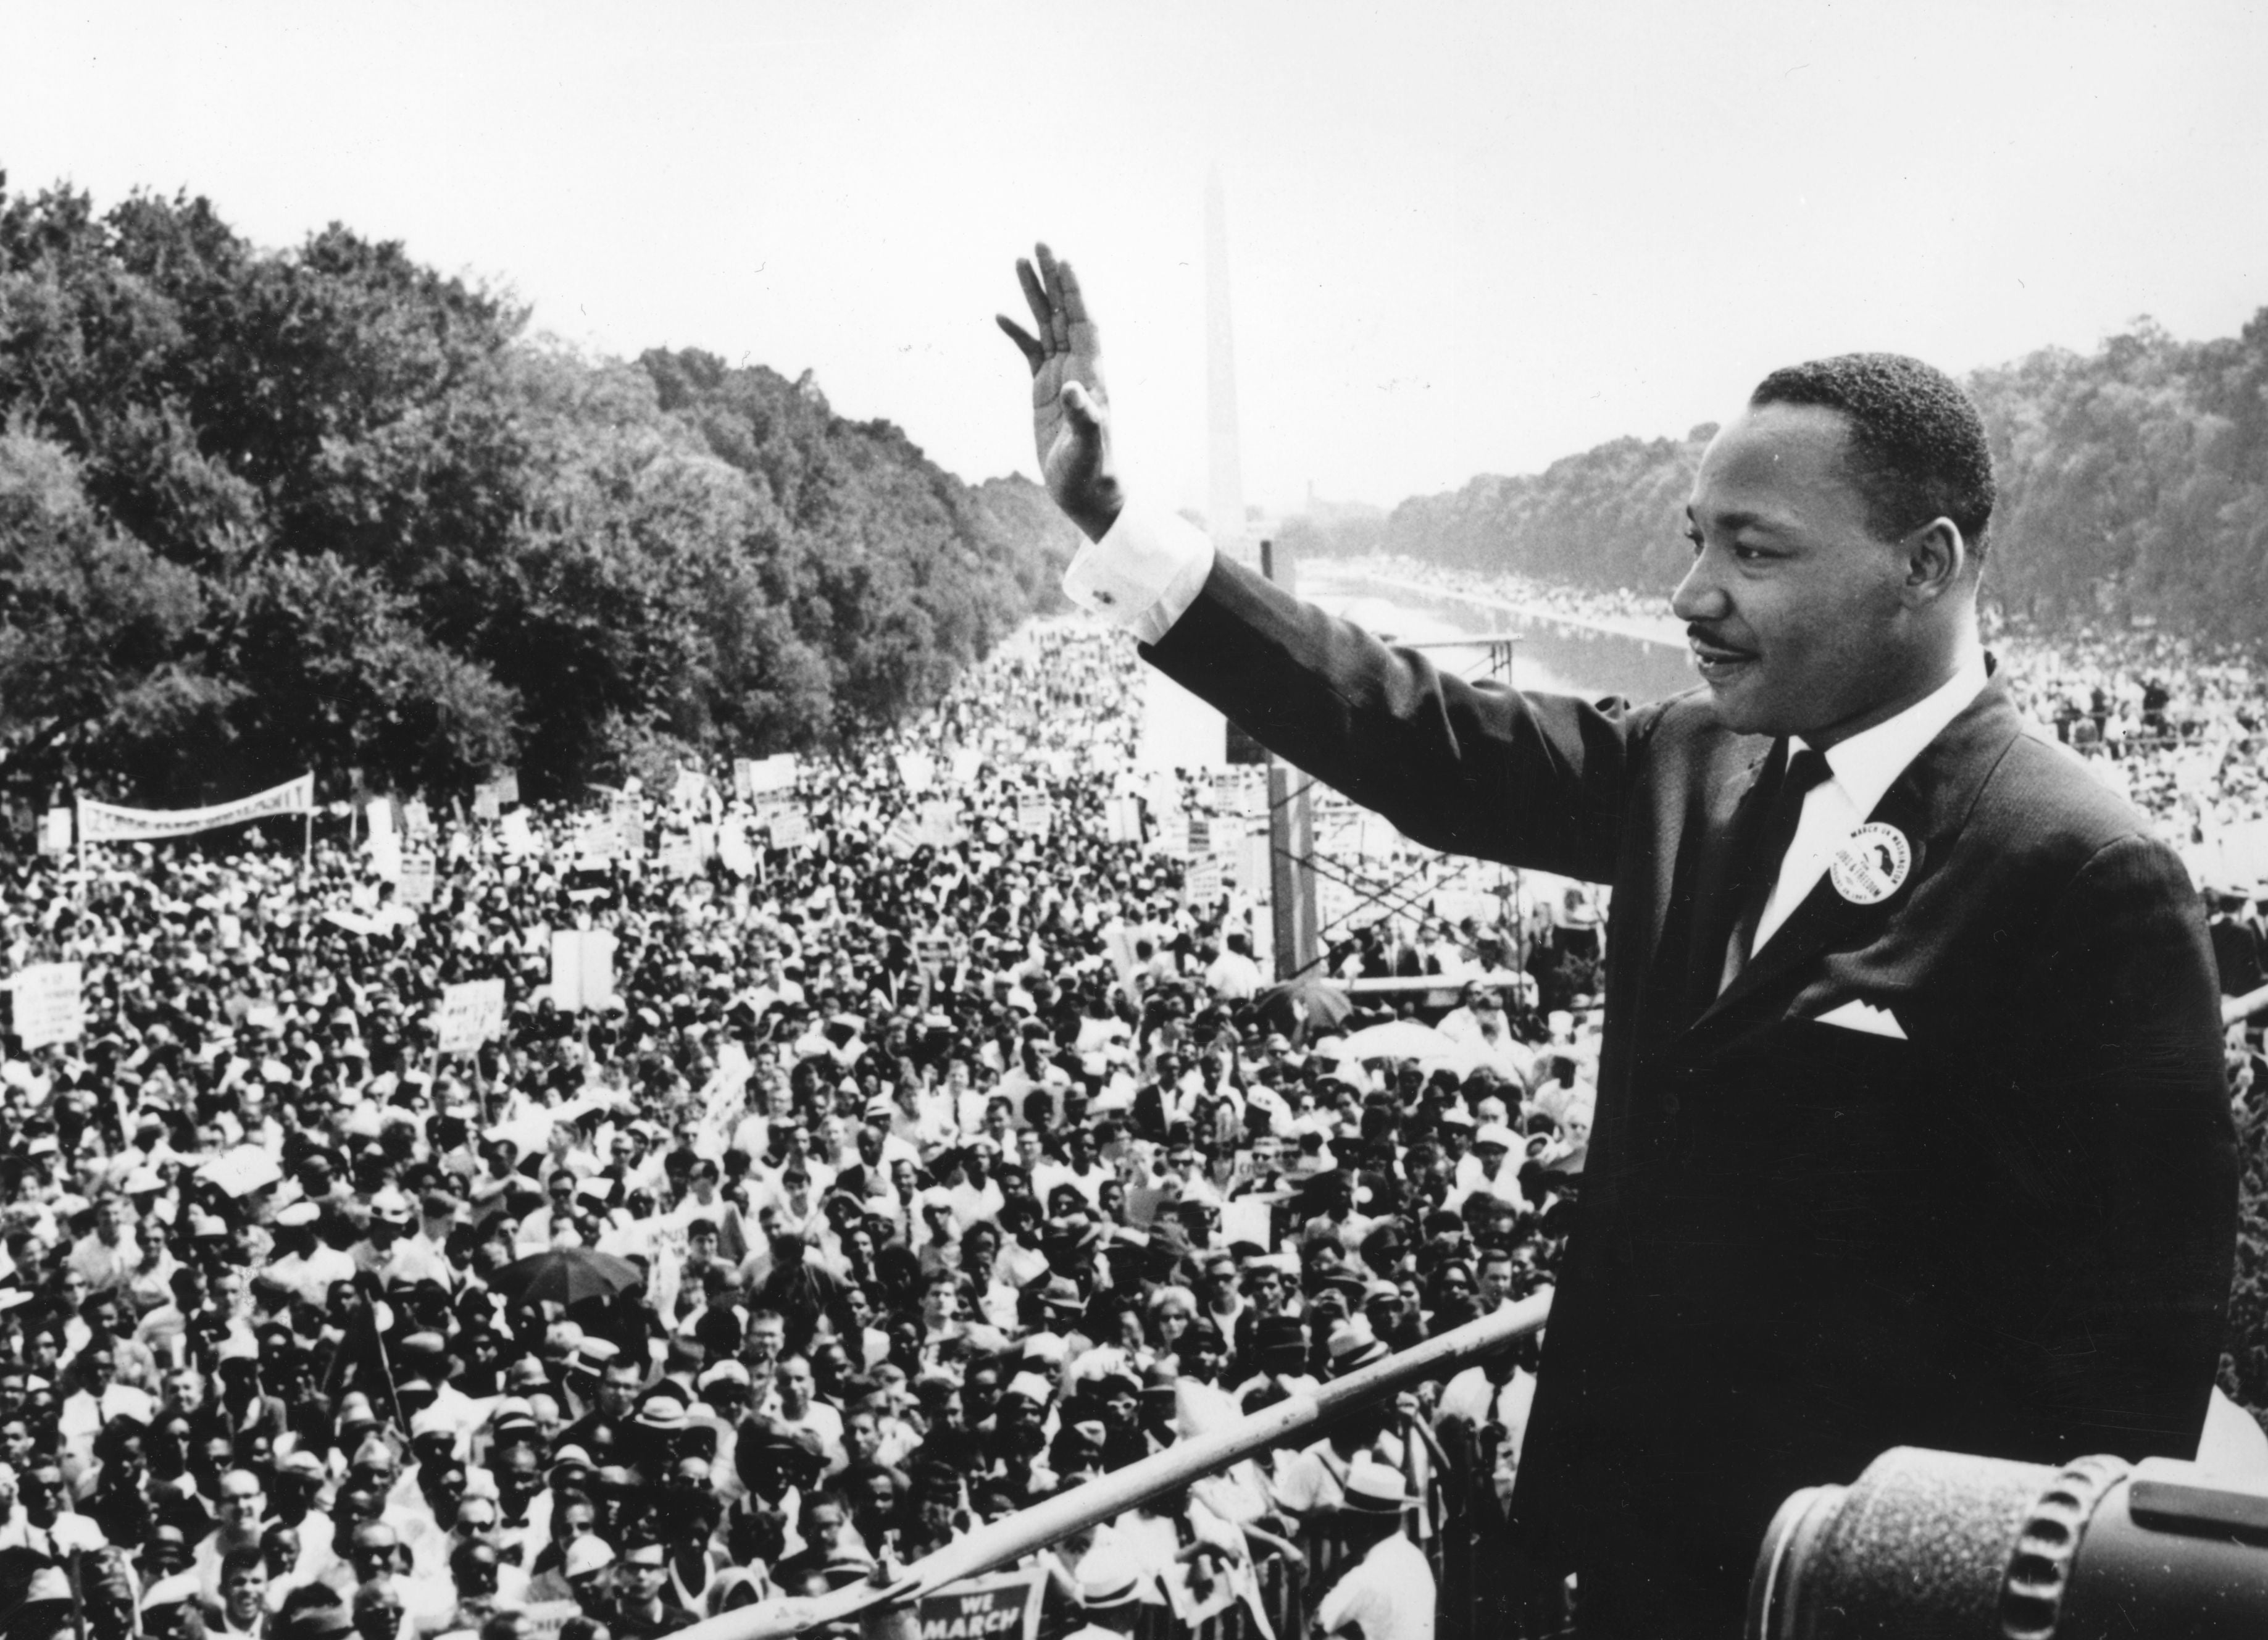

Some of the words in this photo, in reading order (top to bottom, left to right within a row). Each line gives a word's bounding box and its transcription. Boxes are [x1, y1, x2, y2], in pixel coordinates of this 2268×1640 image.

[1850, 826, 1878, 839] MARCH
[1891, 835, 1906, 884] WASHINGTON
[1854, 868, 1882, 898] FREEDOM
[921, 1607, 1020, 1640] MARCH
